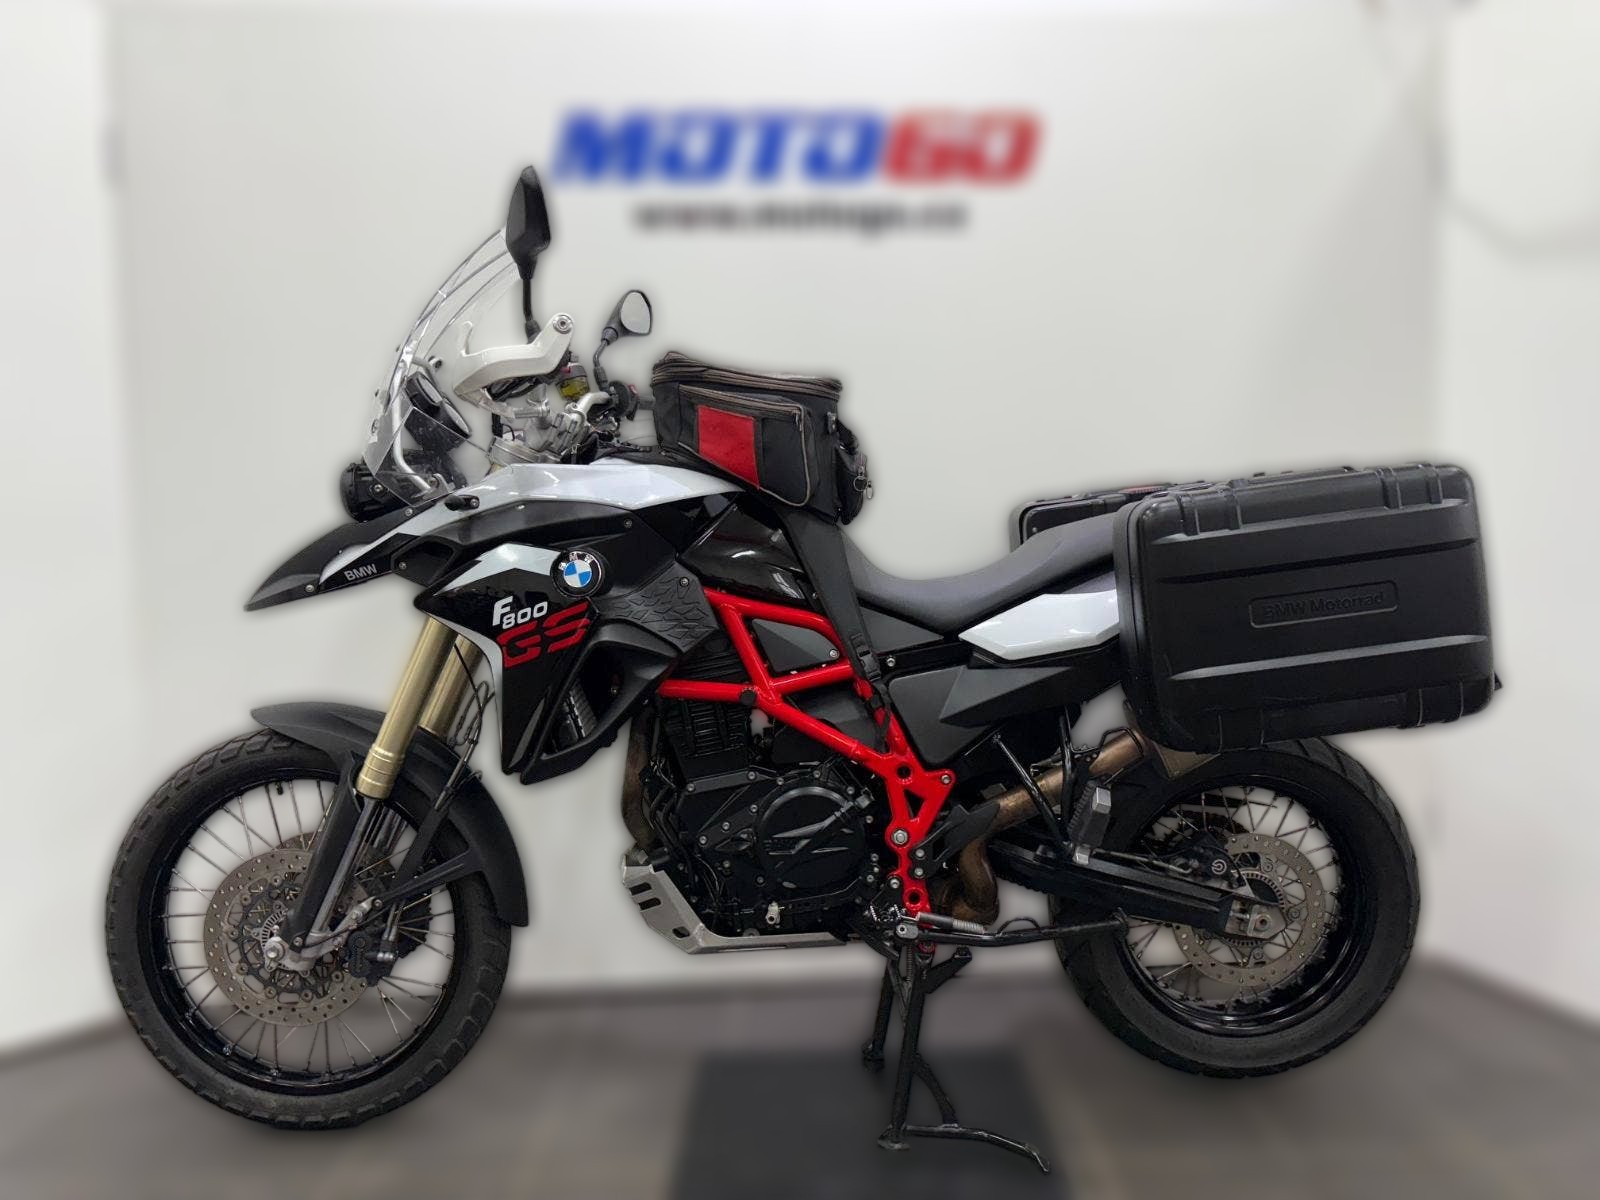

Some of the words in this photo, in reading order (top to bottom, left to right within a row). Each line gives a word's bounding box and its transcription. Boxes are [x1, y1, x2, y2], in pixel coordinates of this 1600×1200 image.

[552, 107, 1041, 186] MOTOGO
[343, 563, 378, 581] BMW
[1310, 591, 1384, 612] Motorrad
[496, 602, 591, 668] GS
